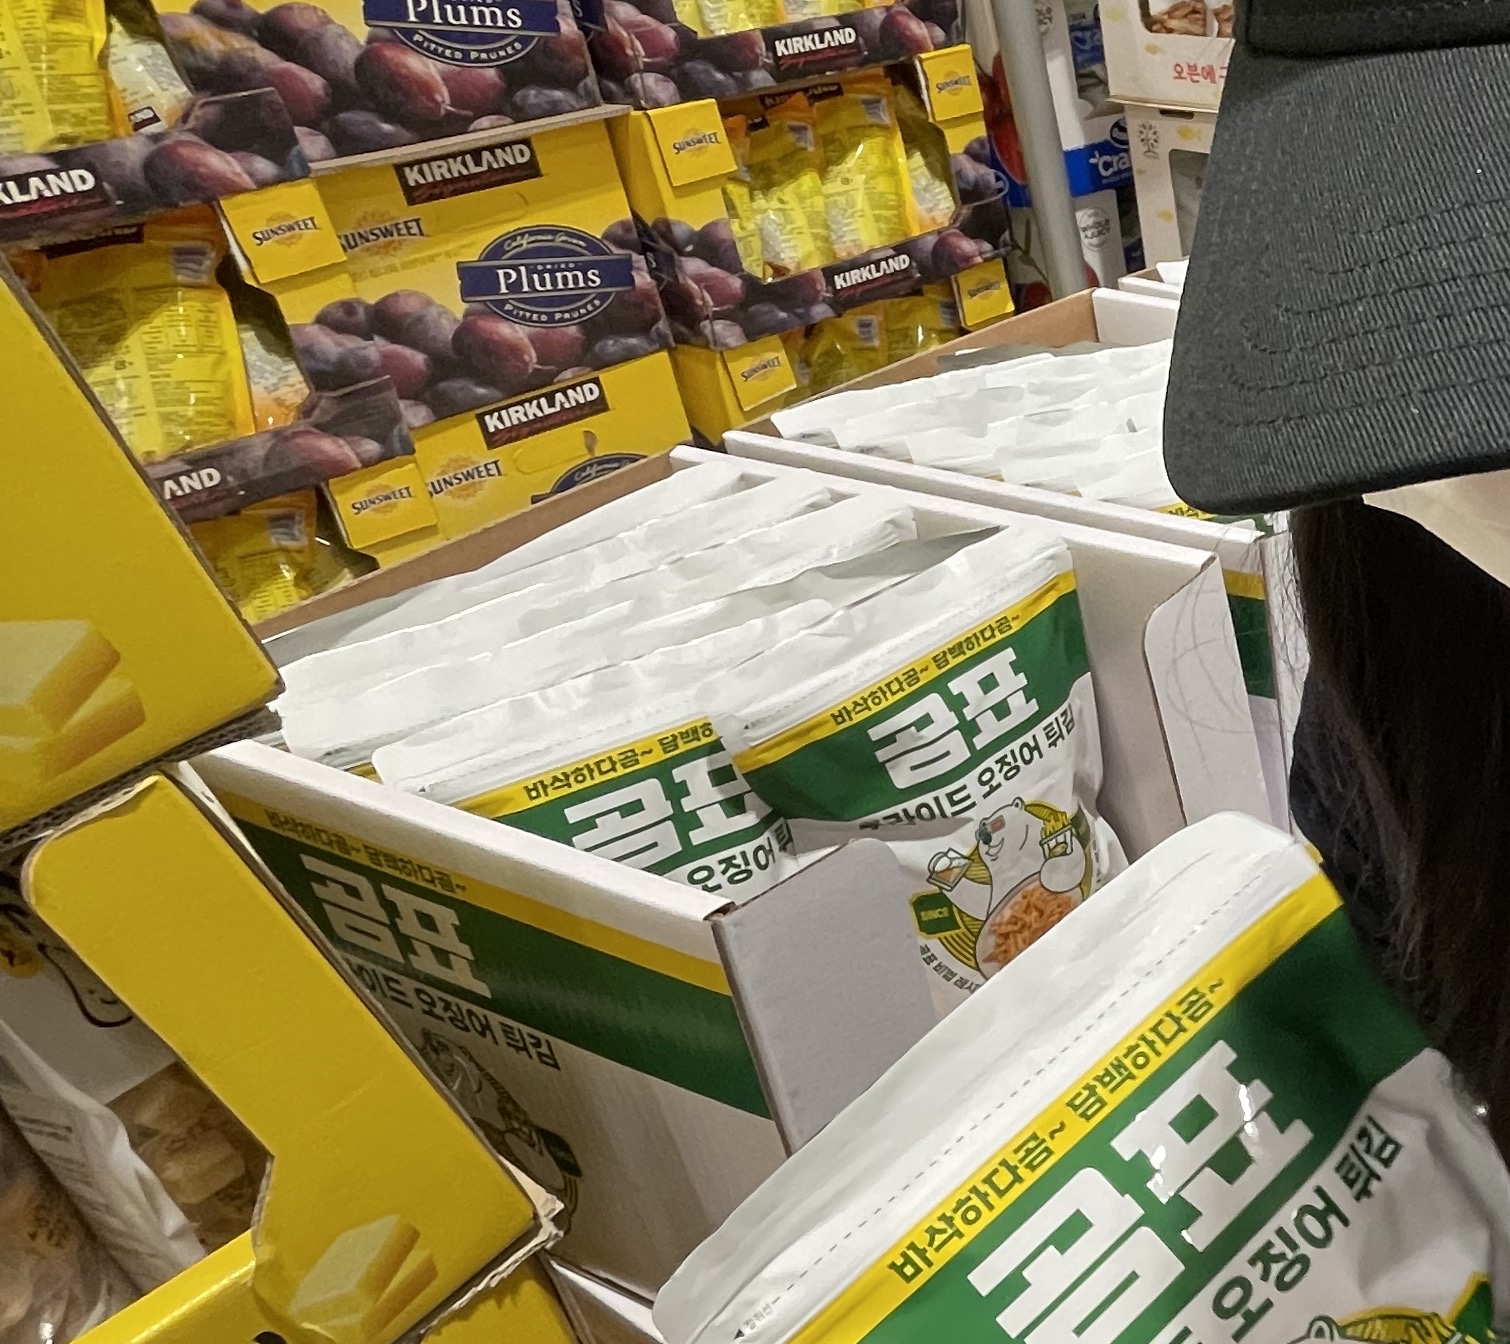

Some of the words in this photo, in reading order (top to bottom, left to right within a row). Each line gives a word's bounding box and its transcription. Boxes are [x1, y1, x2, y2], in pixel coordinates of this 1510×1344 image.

[413, 34, 463, 61] PITTED
[470, 41, 523, 61] PRUNES
[775, 27, 858, 58] KIRKLAND
[1173, 62, 1216, 85] 오븐에
[403, 143, 531, 184] KIRKLAND
[251, 215, 318, 246] SUNSWEET
[496, 264, 601, 295] Plums
[834, 254, 911, 289] KIRKLAND
[503, 302, 548, 322] PITTED
[553, 297, 601, 321] PRUNES
[484, 382, 600, 433] KIRKLAND
[352, 486, 413, 516] SUNSWEET
[866, 646, 1040, 790] 곰표
[523, 747, 655, 802] 바삭하다곰~
[975, 740, 1045, 799] 오징어
[685, 833, 775, 894] 오징어
[300, 854, 493, 999] 곰표
[418, 987, 499, 1046] 오징어
[504, 1025, 562, 1072] 튀김
[886, 1120, 1068, 1285] 바삭하다곰~
[1064, 977, 1226, 1123] 담백하다곰~
[1211, 1184, 1352, 1344] 오징어
[1332, 1113, 1406, 1203] 튀김
